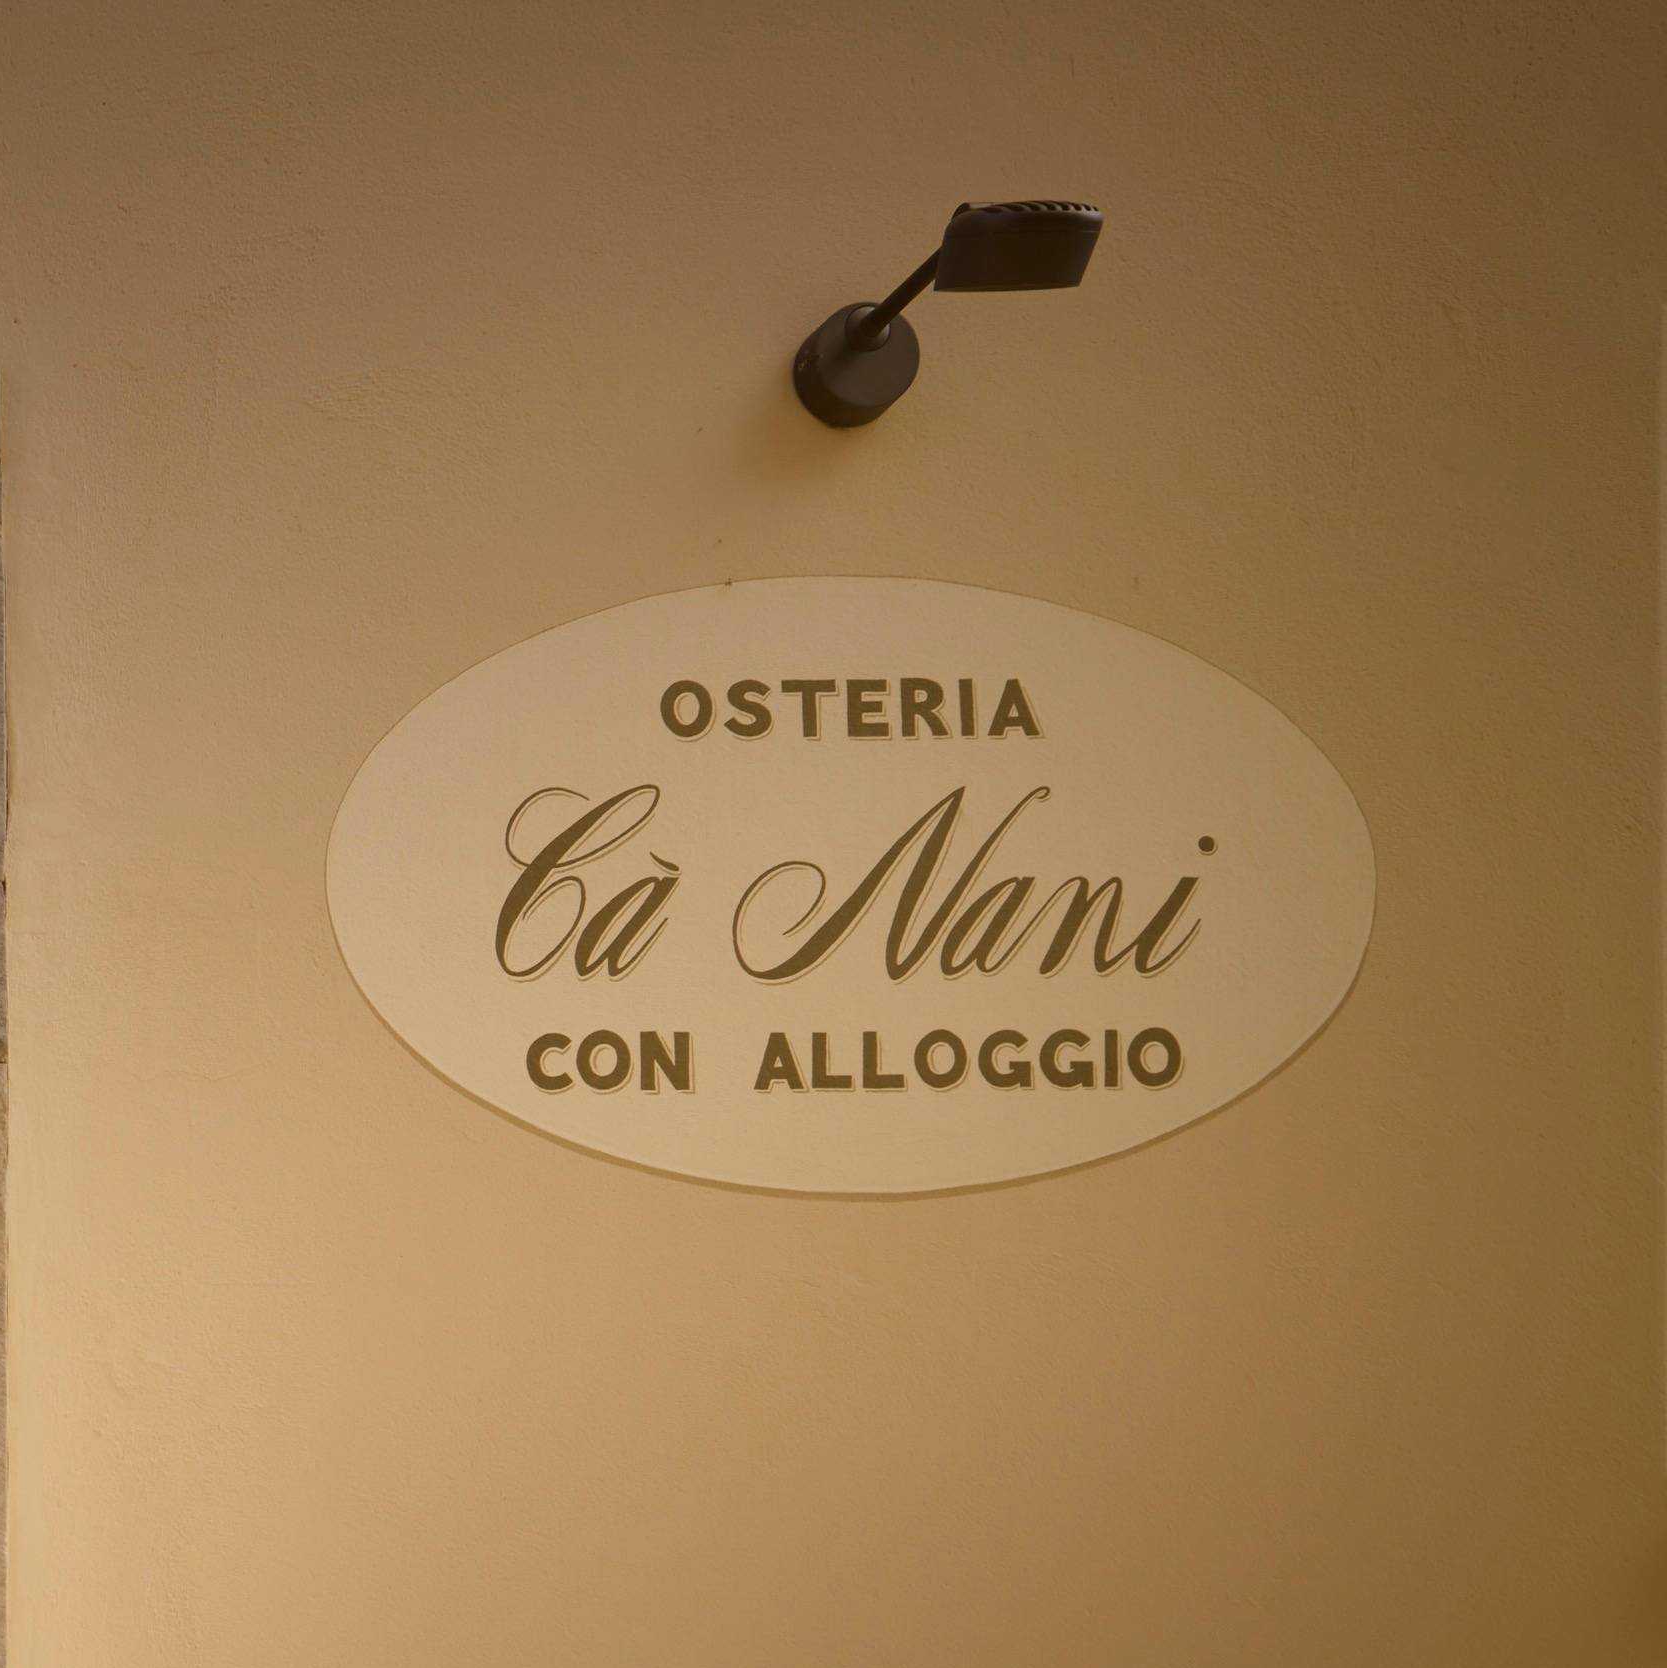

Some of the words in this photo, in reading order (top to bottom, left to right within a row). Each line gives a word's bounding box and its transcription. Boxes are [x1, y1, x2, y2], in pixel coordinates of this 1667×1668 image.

[659, 677, 1043, 739] OSTERIA
[494, 783, 680, 979] Cà
[732, 785, 1217, 981] Nani
[526, 1028, 691, 1091] CON
[754, 1026, 1183, 1091] ALLOGGIO
